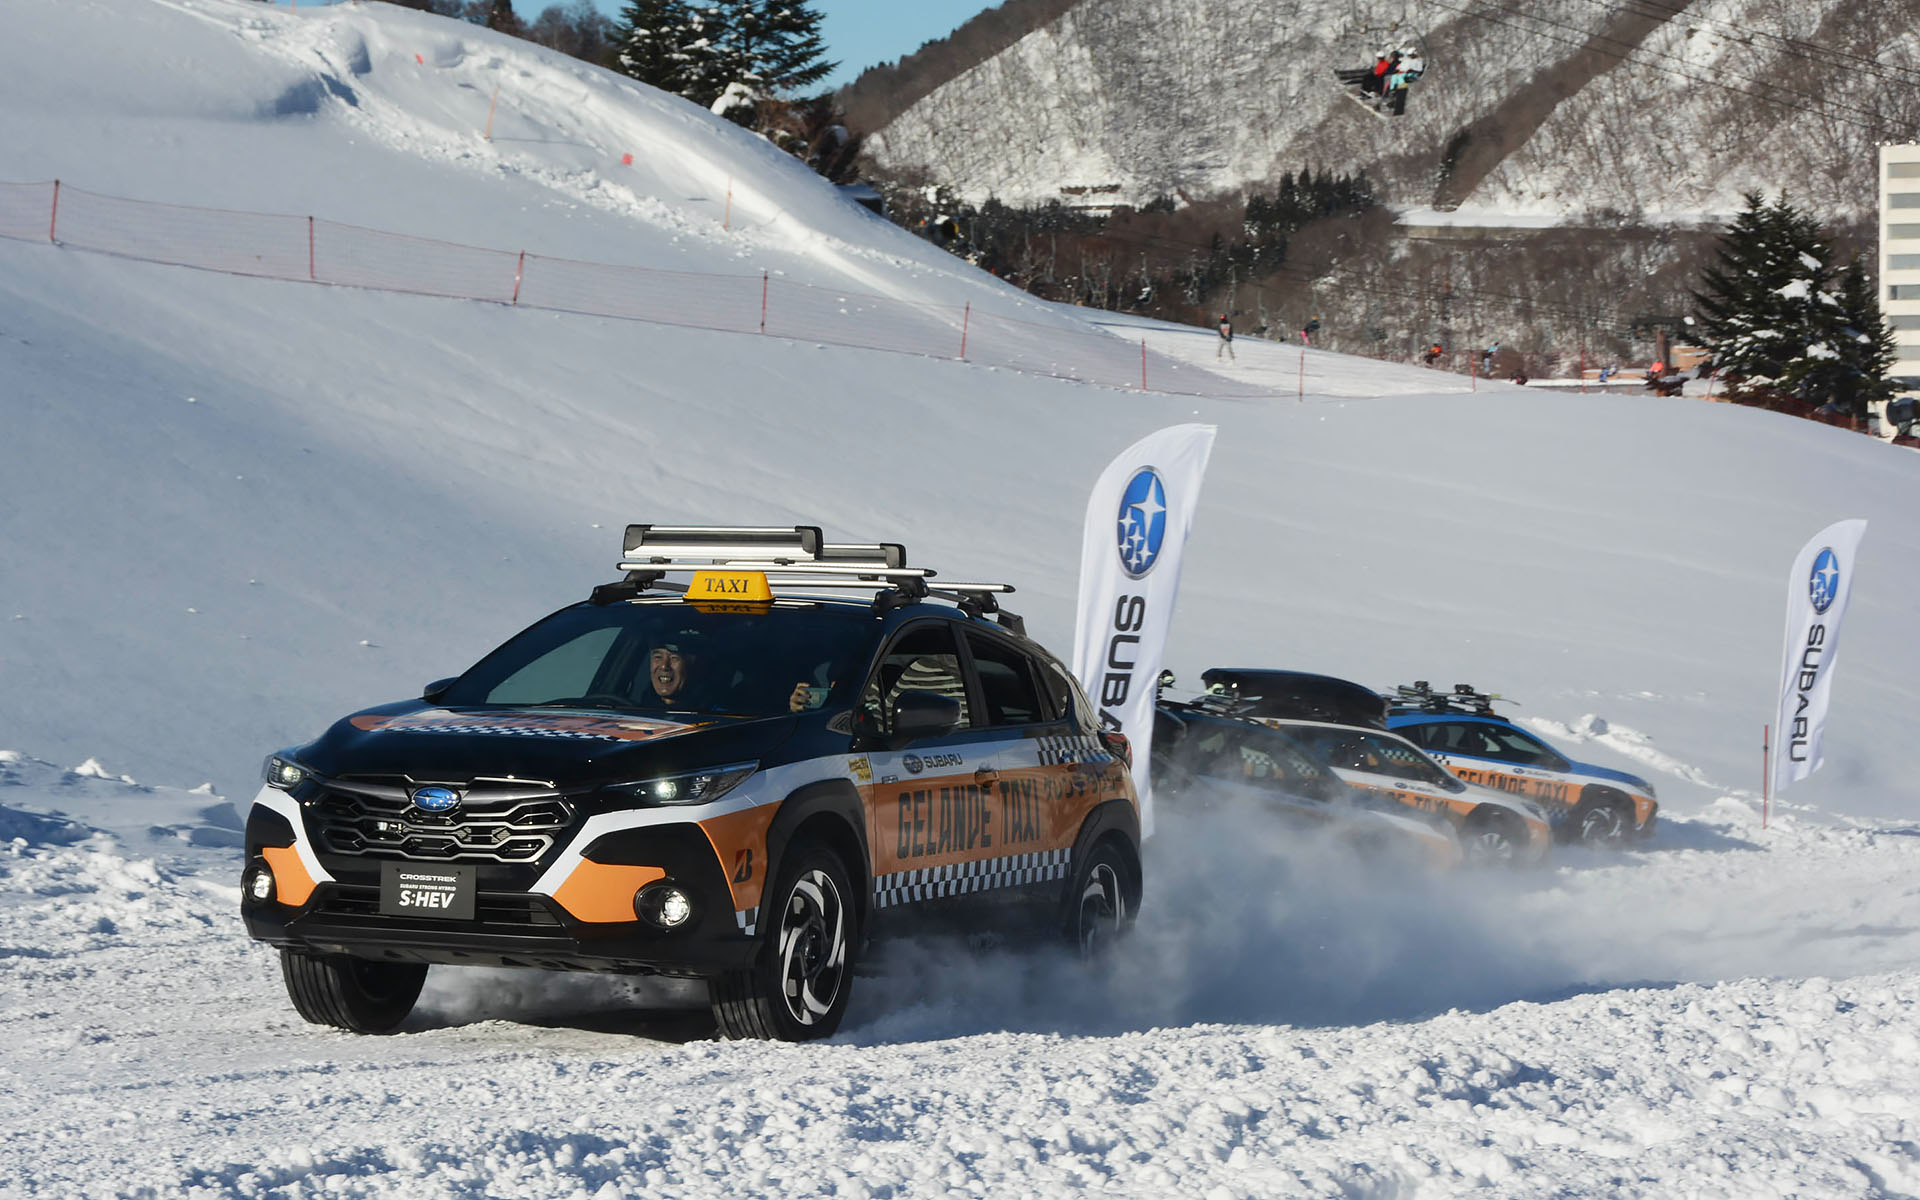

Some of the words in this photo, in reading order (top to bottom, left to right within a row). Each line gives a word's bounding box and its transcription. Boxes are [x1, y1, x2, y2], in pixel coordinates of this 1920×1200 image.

[704, 578, 749, 593] TAXI
[1099, 594, 1146, 732] SUBA
[1790, 624, 1825, 762] SUBARU
[924, 754, 963, 769] SUBARU
[897, 784, 992, 859] GELANDE
[1000, 778, 1041, 844] TAXI
[400, 873, 457, 883] CROSSTREK
[399, 890, 455, 909] S:HEV
